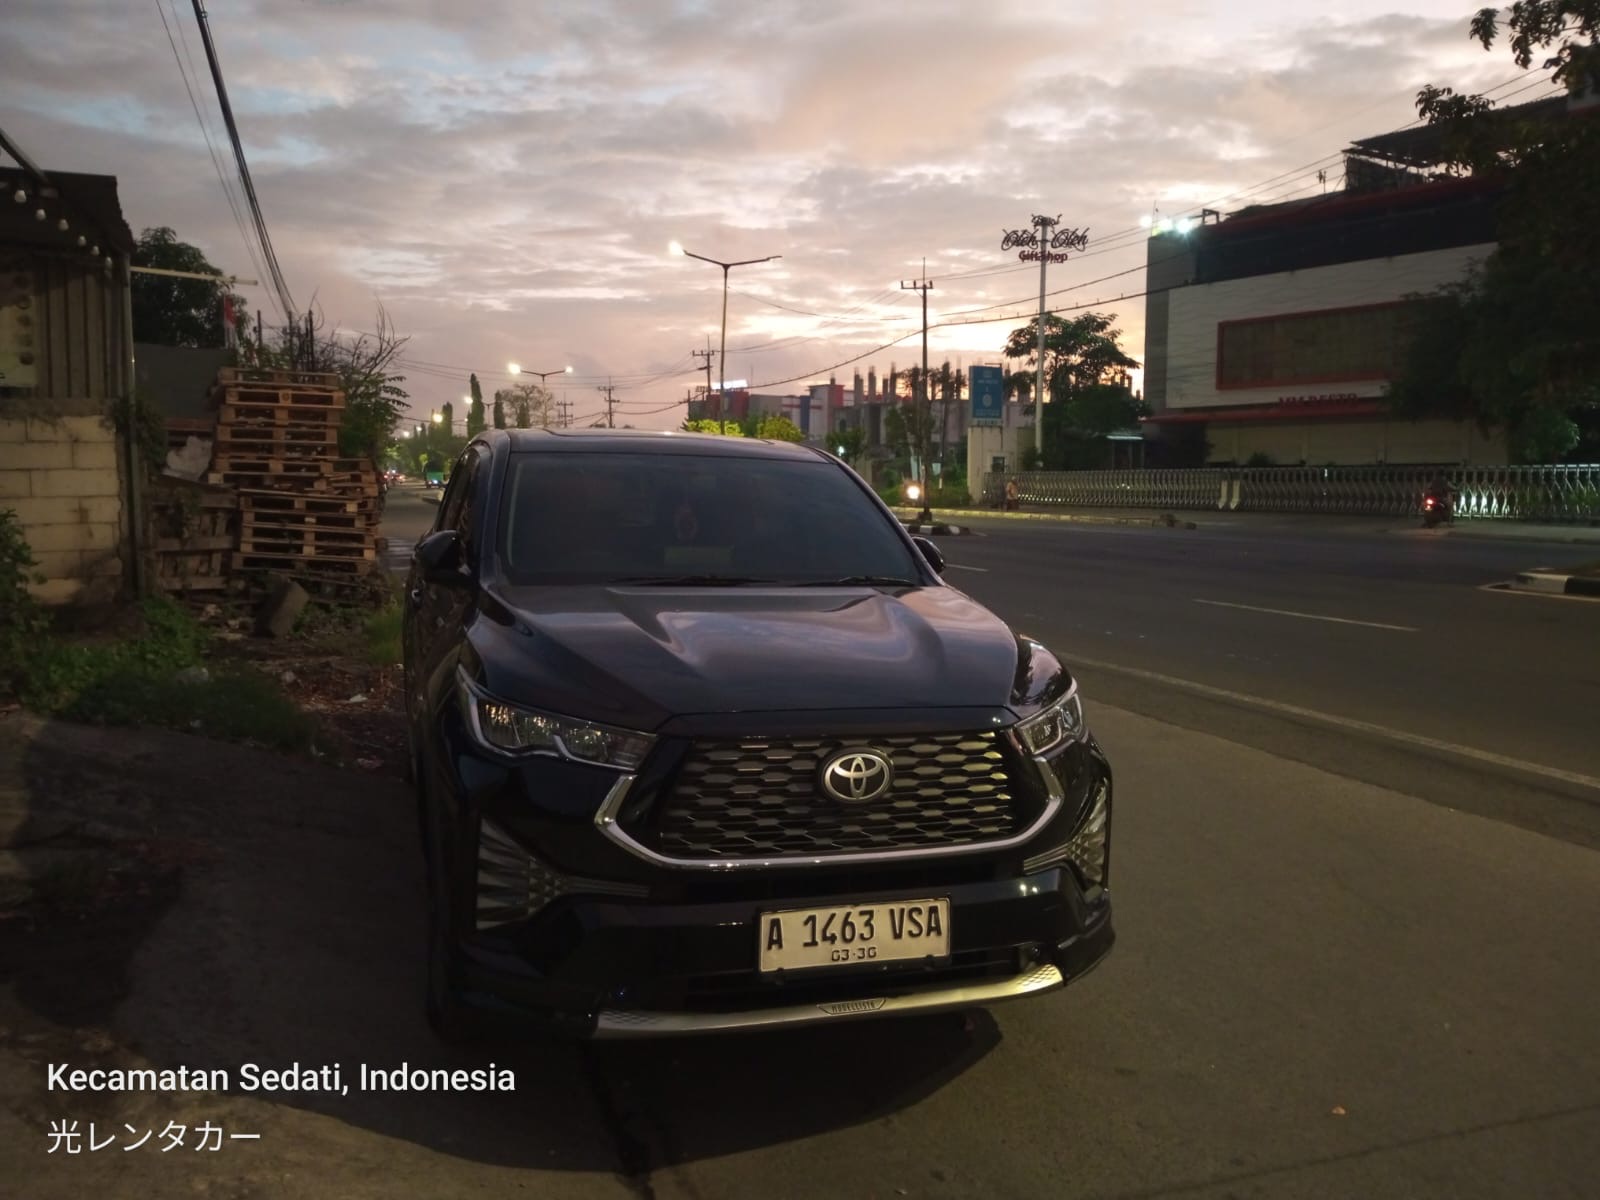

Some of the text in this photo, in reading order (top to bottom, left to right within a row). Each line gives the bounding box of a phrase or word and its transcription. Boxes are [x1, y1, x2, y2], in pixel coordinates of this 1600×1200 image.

[767, 905, 942, 951] A 1463 VSA
